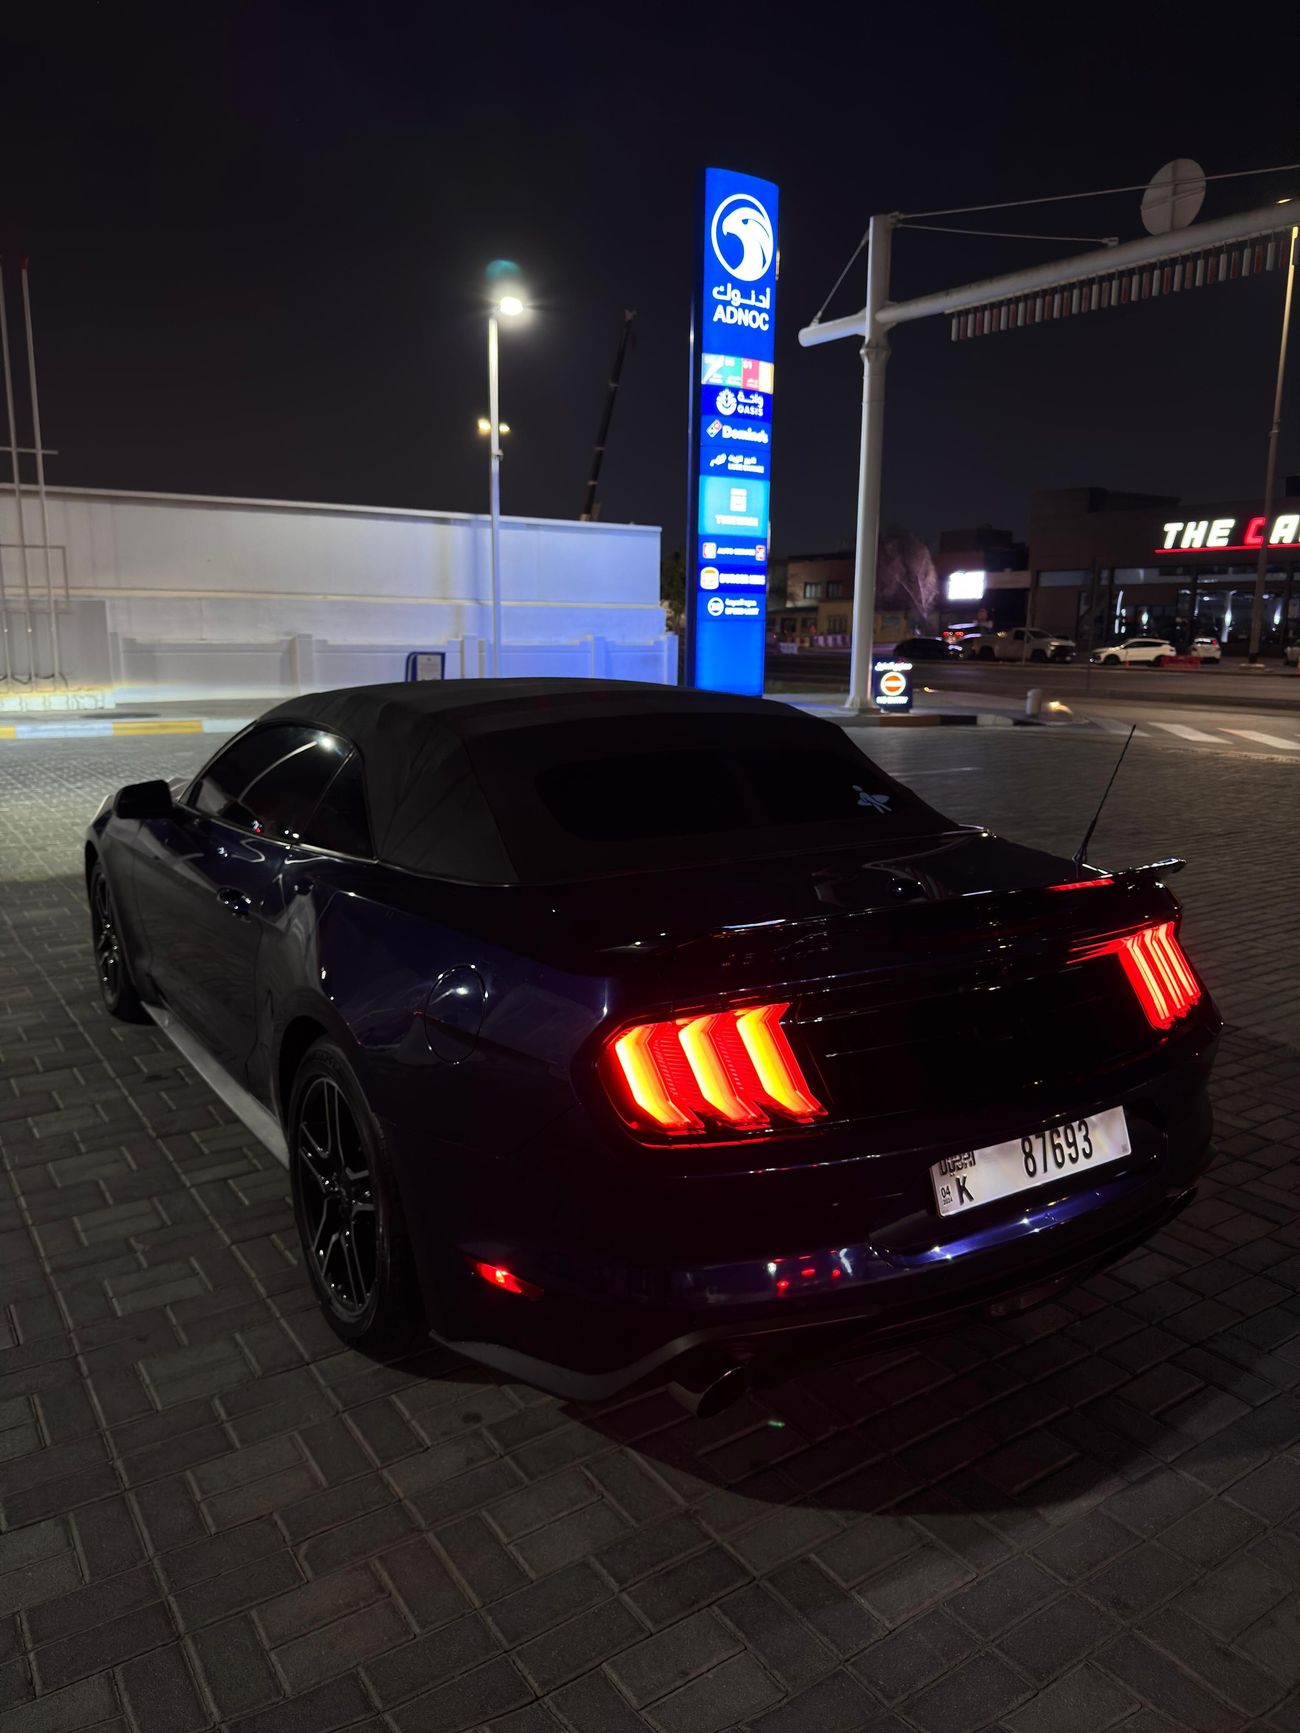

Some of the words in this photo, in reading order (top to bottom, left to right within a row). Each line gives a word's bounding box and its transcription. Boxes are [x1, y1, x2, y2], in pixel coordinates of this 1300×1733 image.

[713, 304, 769, 331] ADNOC
[737, 405, 764, 416] OASIS
[1163, 518, 1236, 549] THE
[1243, 514, 1300, 546] CA
[1021, 1119, 1093, 1178] 87693
[940, 1185, 951, 1198] 04
[955, 1175, 974, 1206] K
